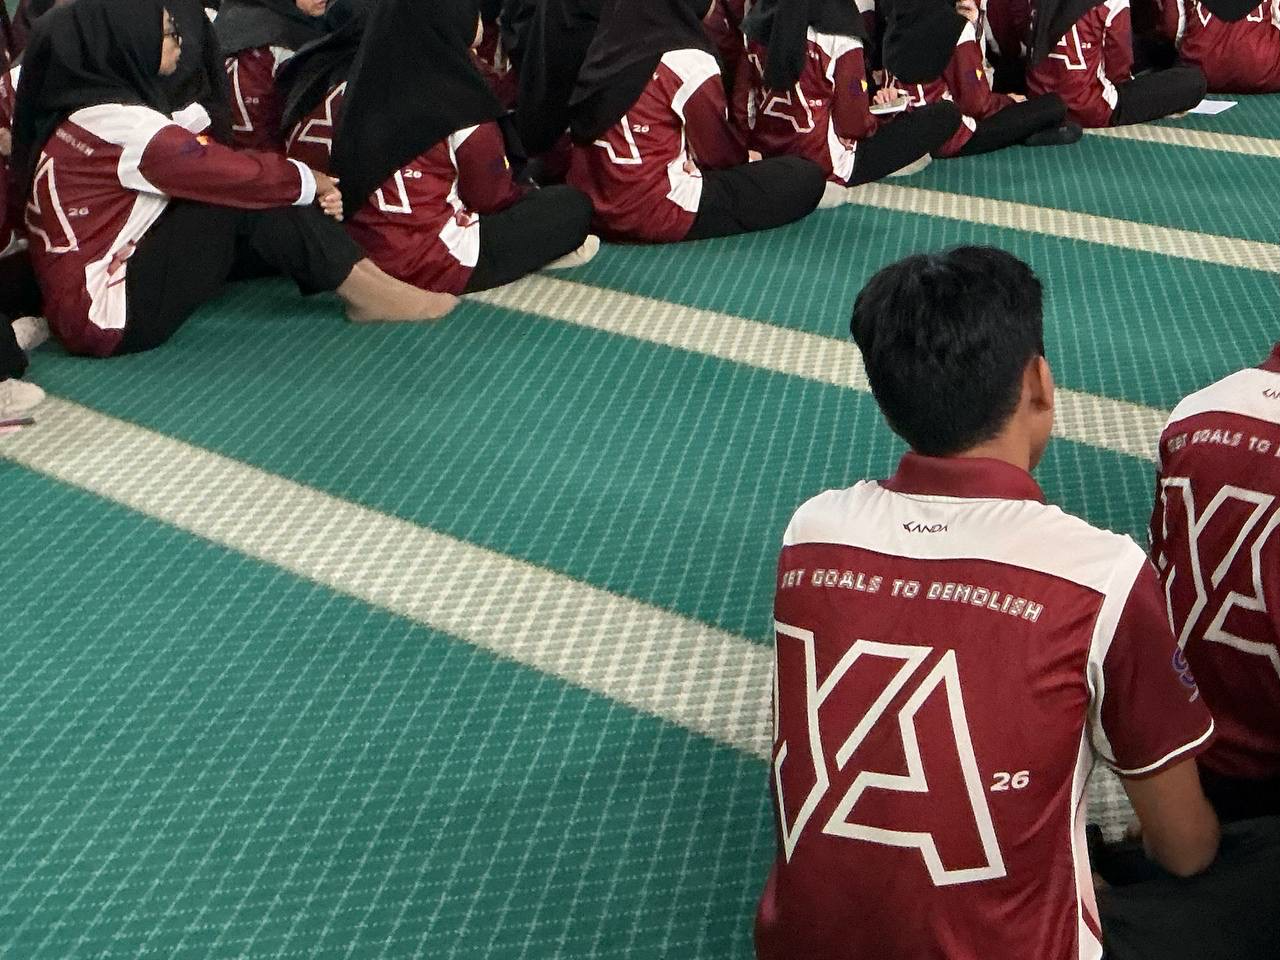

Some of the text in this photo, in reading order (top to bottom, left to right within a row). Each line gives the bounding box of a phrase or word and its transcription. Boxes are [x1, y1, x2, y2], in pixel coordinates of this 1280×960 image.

[1247, 435, 1271, 455] TO
[811, 569, 882, 593] GOALS
[890, 579, 919, 599] TO
[926, 581, 1045, 624] DEMOLISH
[989, 769, 1031, 793] 26
